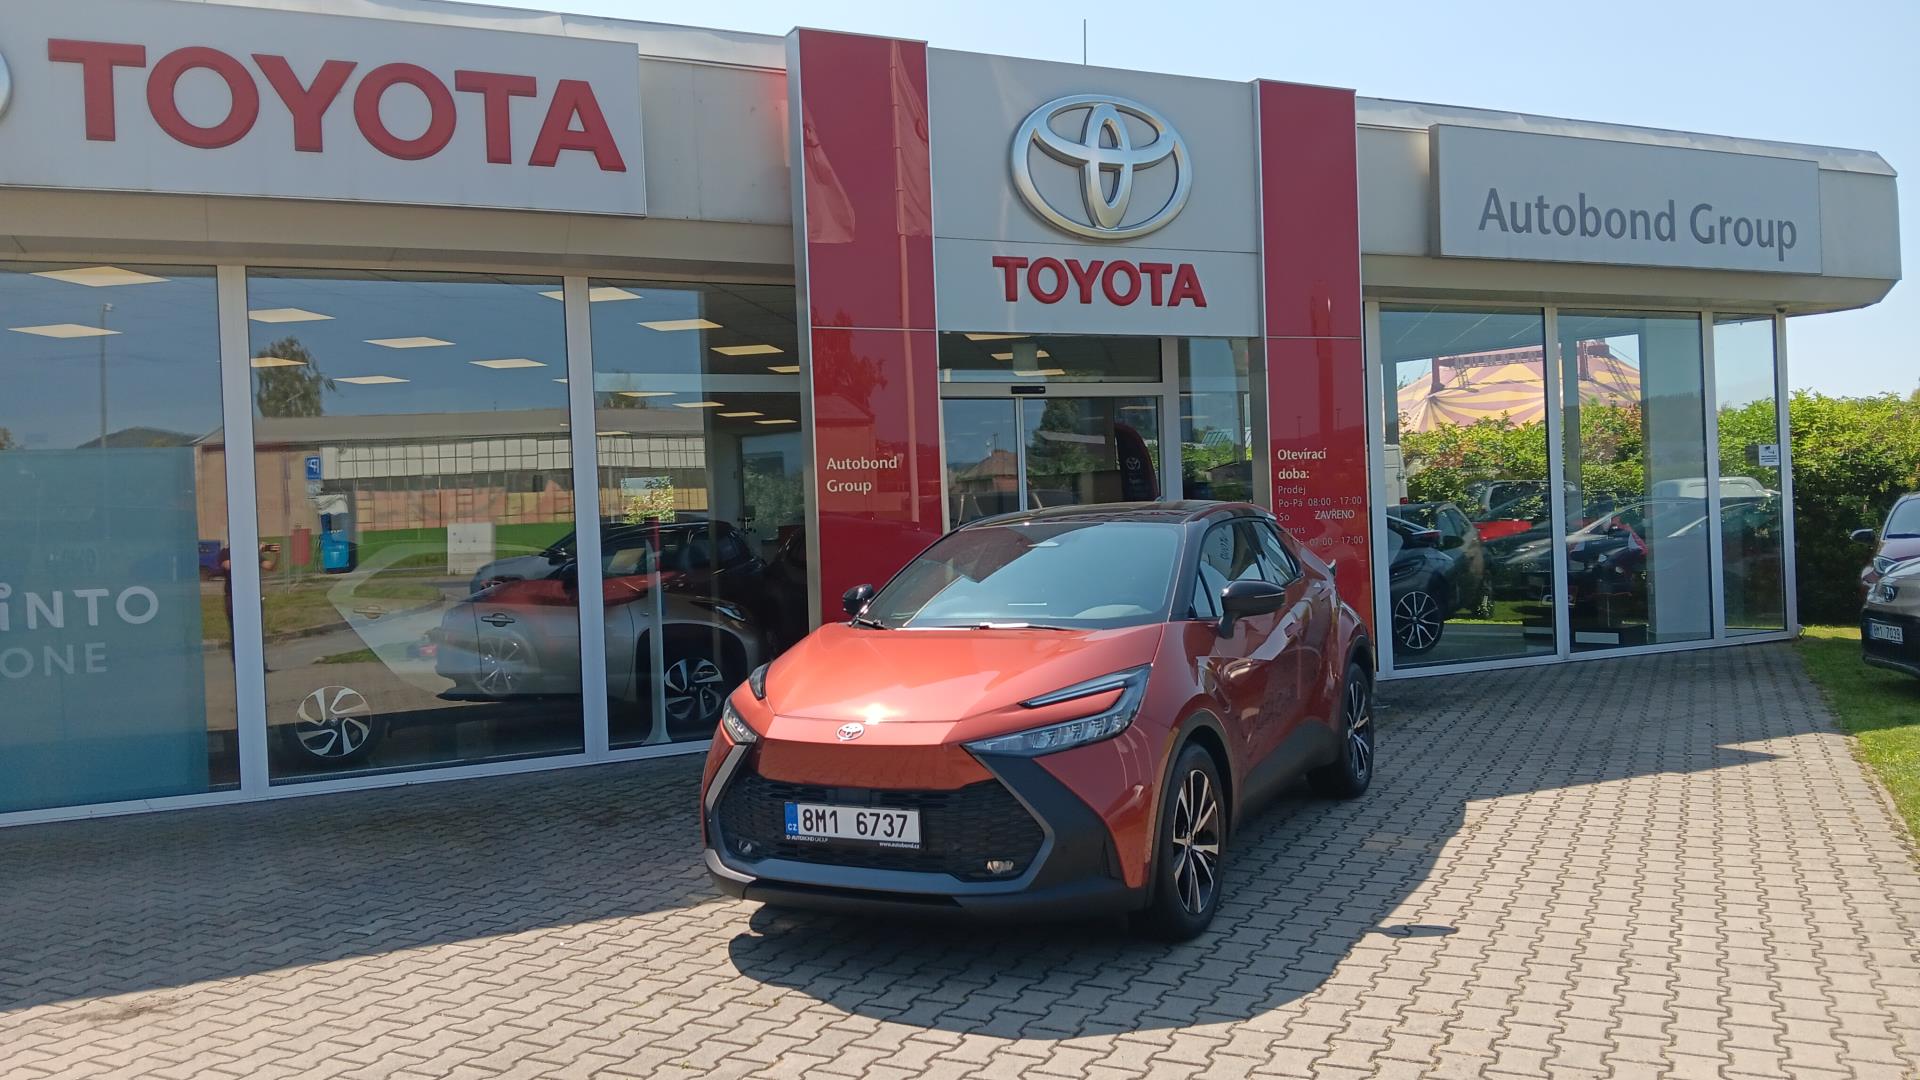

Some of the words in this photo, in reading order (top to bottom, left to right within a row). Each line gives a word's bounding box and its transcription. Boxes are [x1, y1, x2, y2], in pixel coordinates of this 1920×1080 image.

[47, 38, 627, 172] TOYOTA
[1478, 187, 1677, 242] Autobond
[1689, 203, 1797, 262] Group
[992, 255, 1208, 308] TOYOTA
[1277, 447, 1327, 460] Otevírací
[826, 455, 898, 470] Autobond
[1278, 467, 1310, 480] doba:
[826, 479, 872, 495] Group
[1278, 485, 1306, 496] Prodej
[1278, 498, 1303, 508] Po-Pá
[1307, 497, 1331, 507] 08:00
[1340, 496, 1362, 505] 17:00
[1279, 512, 1290, 522] So
[1314, 508, 1355, 520] ZAVŘENO
[1341, 535, 1364, 545] 17:00
[787, 823, 798, 831] CZ
[802, 808, 839, 834] 8M1
[856, 811, 908, 838] 6737
